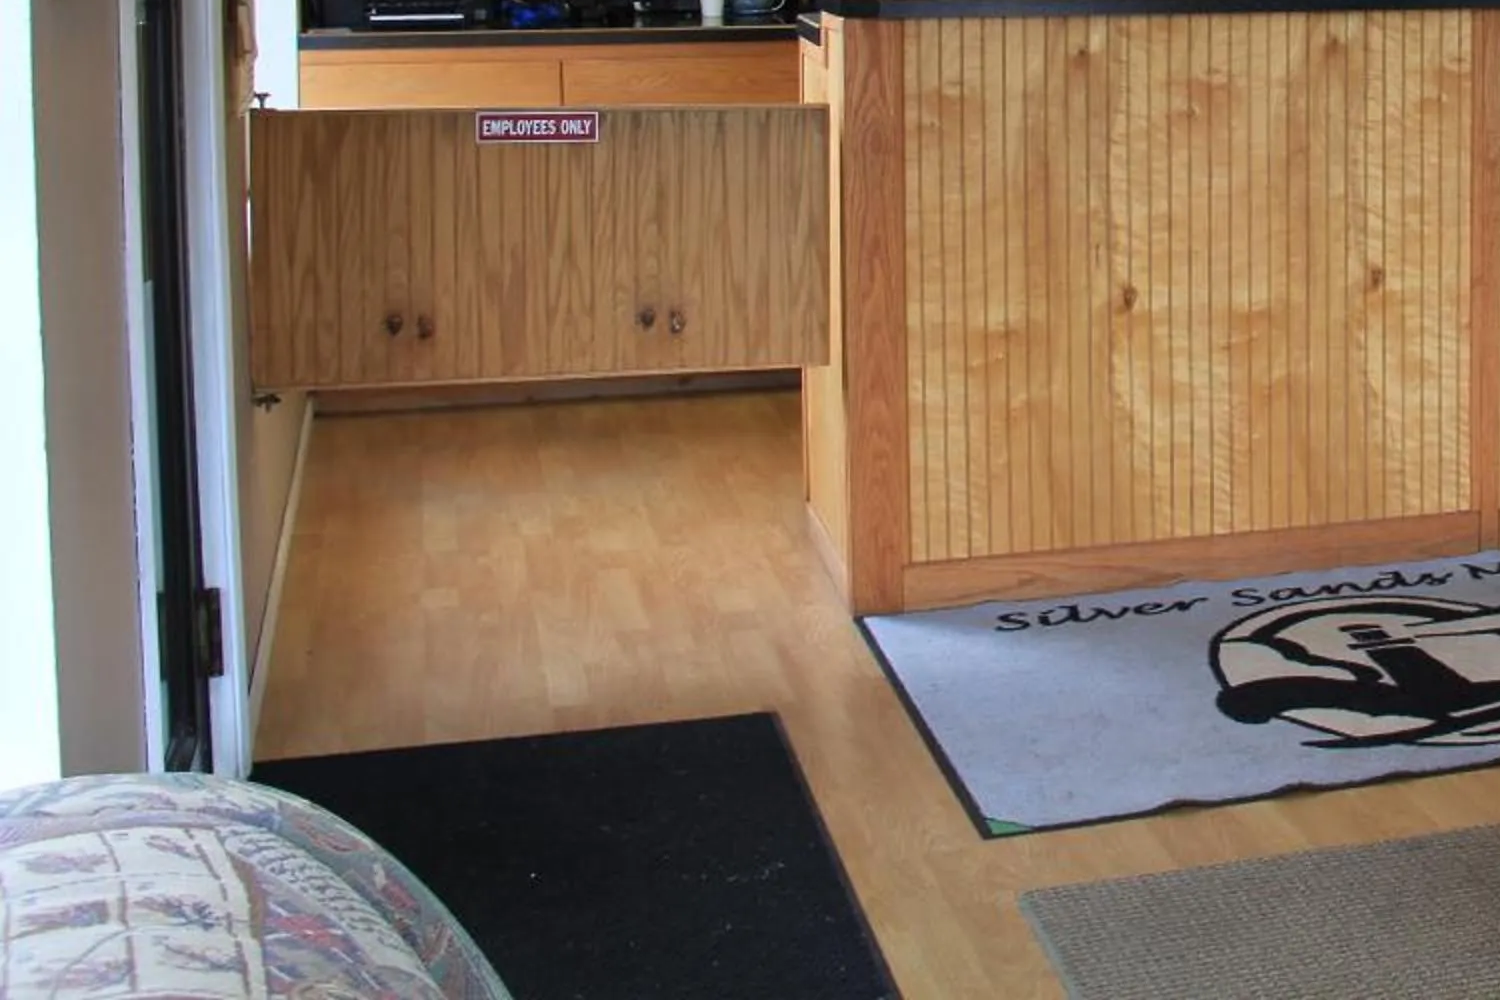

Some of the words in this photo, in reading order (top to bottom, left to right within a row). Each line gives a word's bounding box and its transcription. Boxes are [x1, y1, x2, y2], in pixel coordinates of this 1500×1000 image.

[482, 119, 557, 136] EMPLOYEES
[560, 119, 593, 136] ONLY
[995, 597, 1209, 632] Silver
[1231, 569, 1454, 607] Sands
